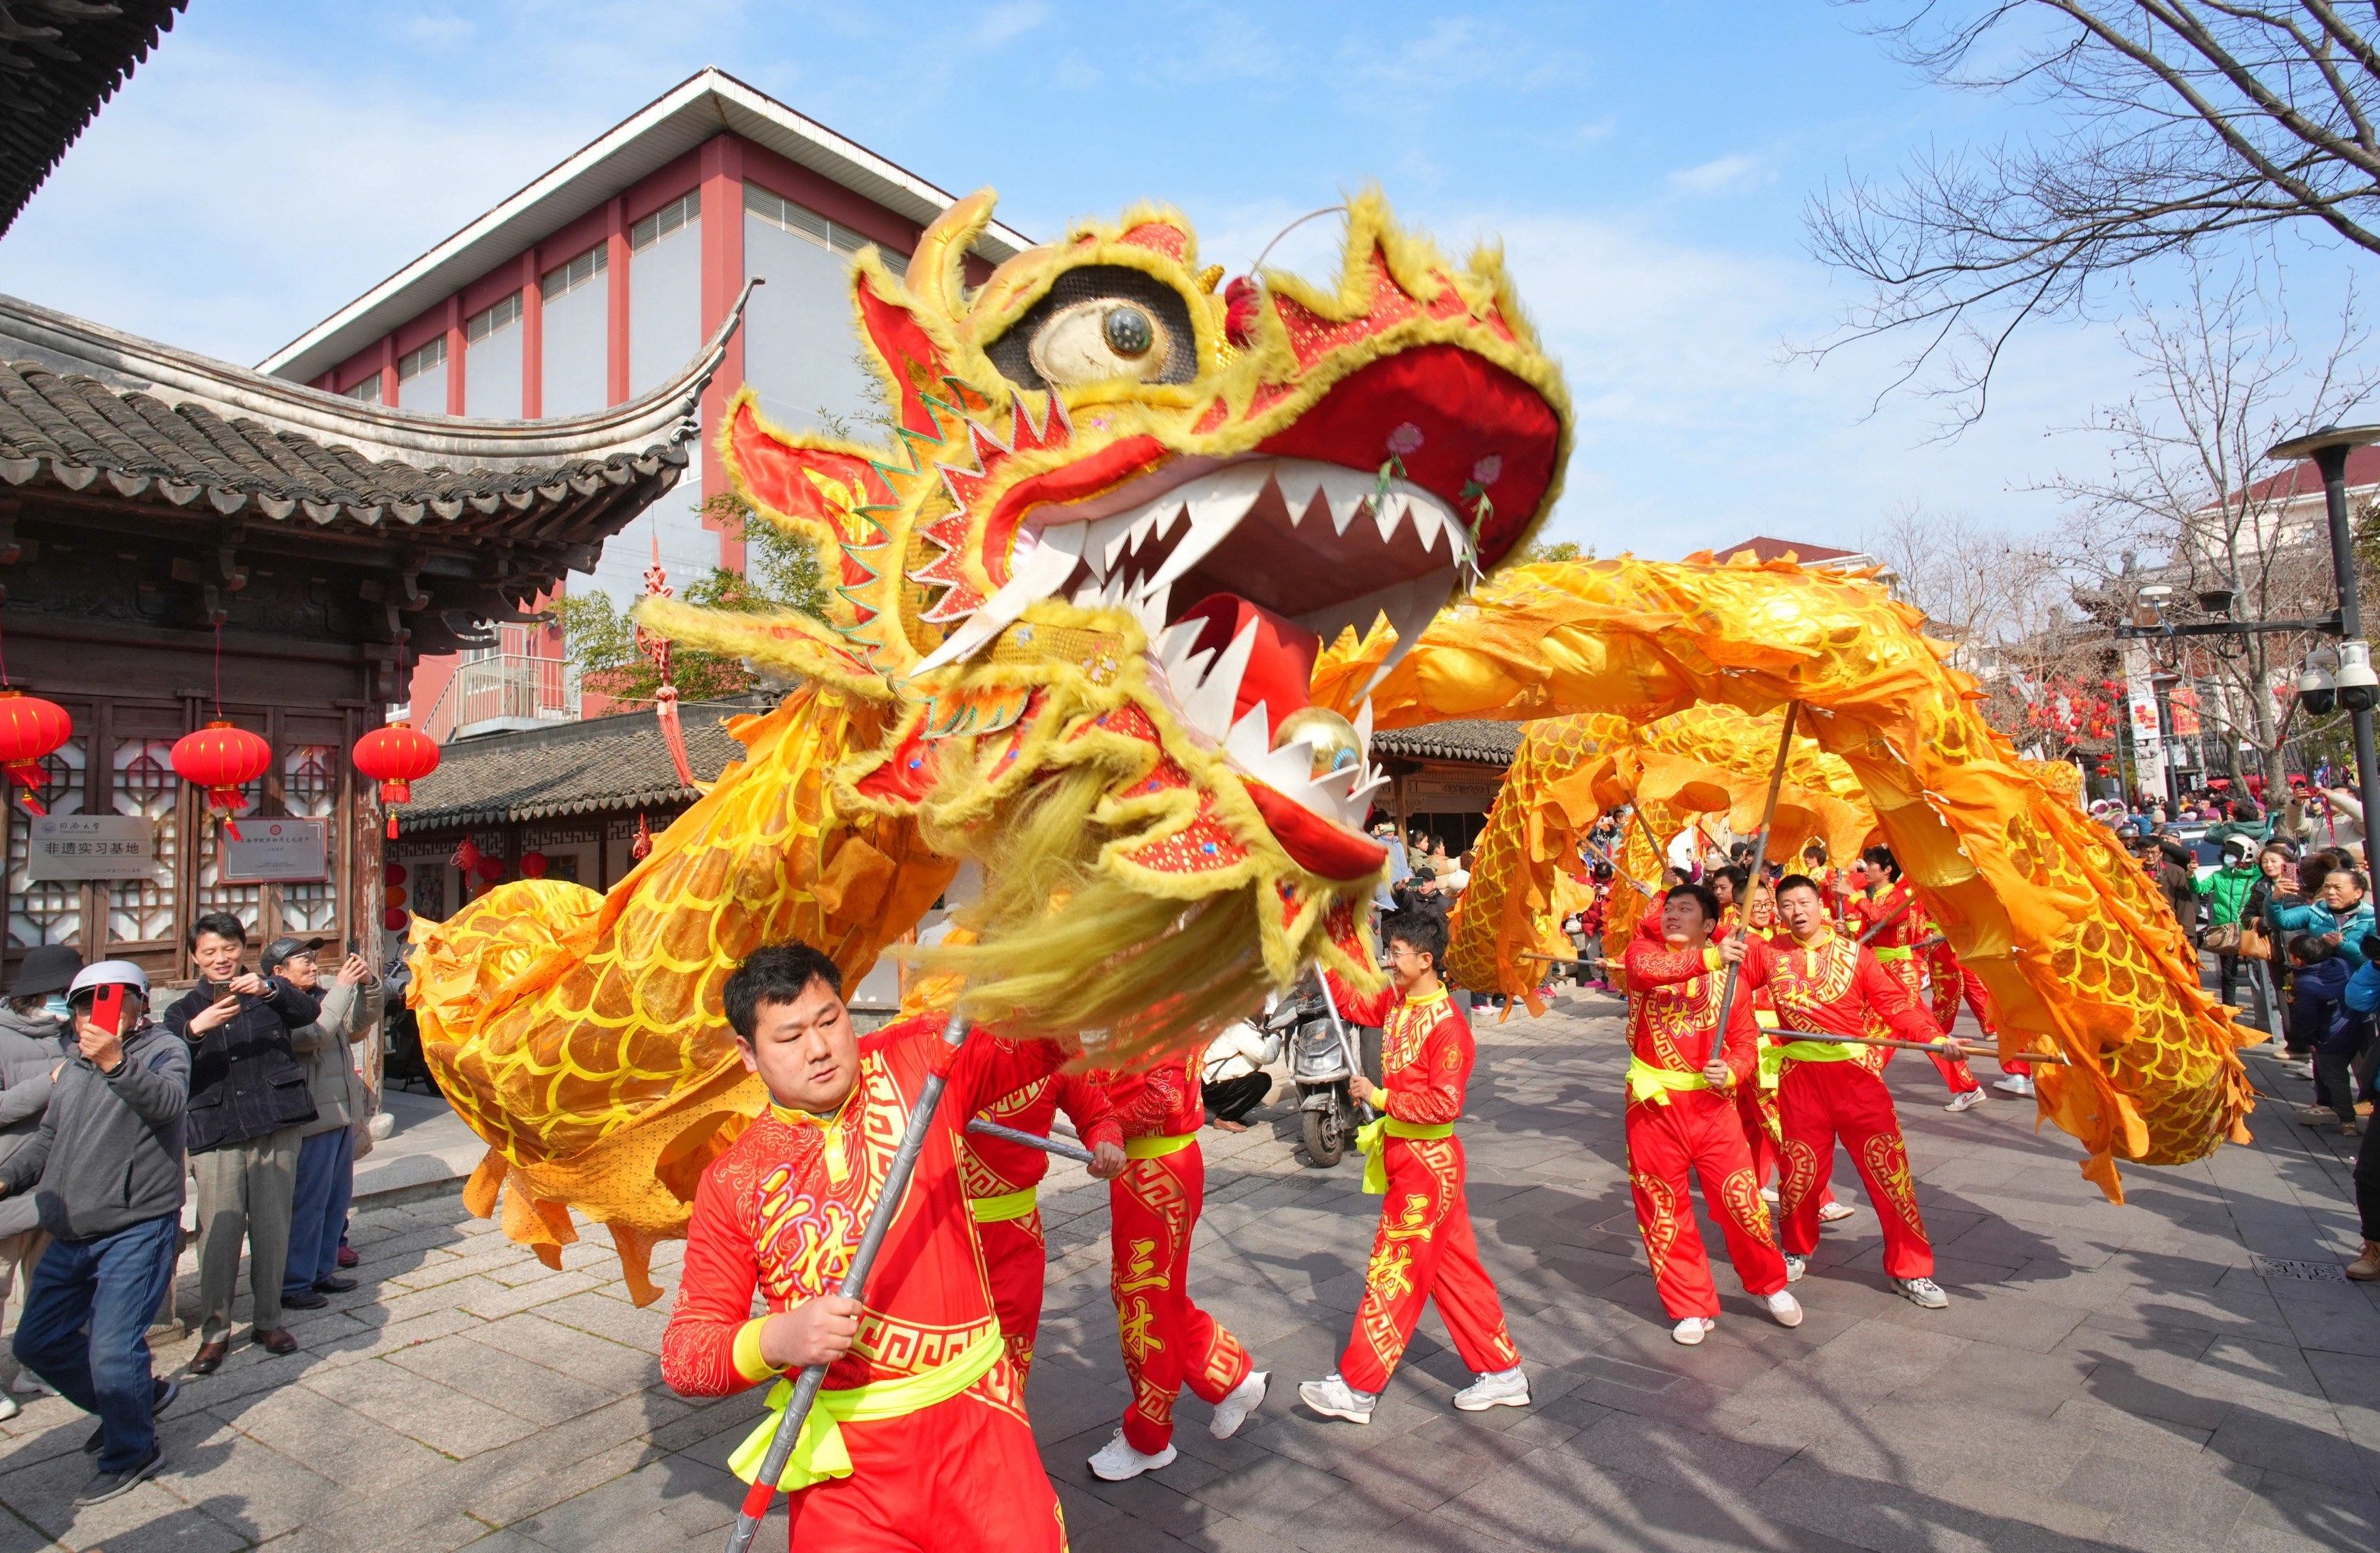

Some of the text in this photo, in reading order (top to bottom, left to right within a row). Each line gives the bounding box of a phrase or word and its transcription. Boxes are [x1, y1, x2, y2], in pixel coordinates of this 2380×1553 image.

[45, 842, 140, 855] 非遗实习基地
